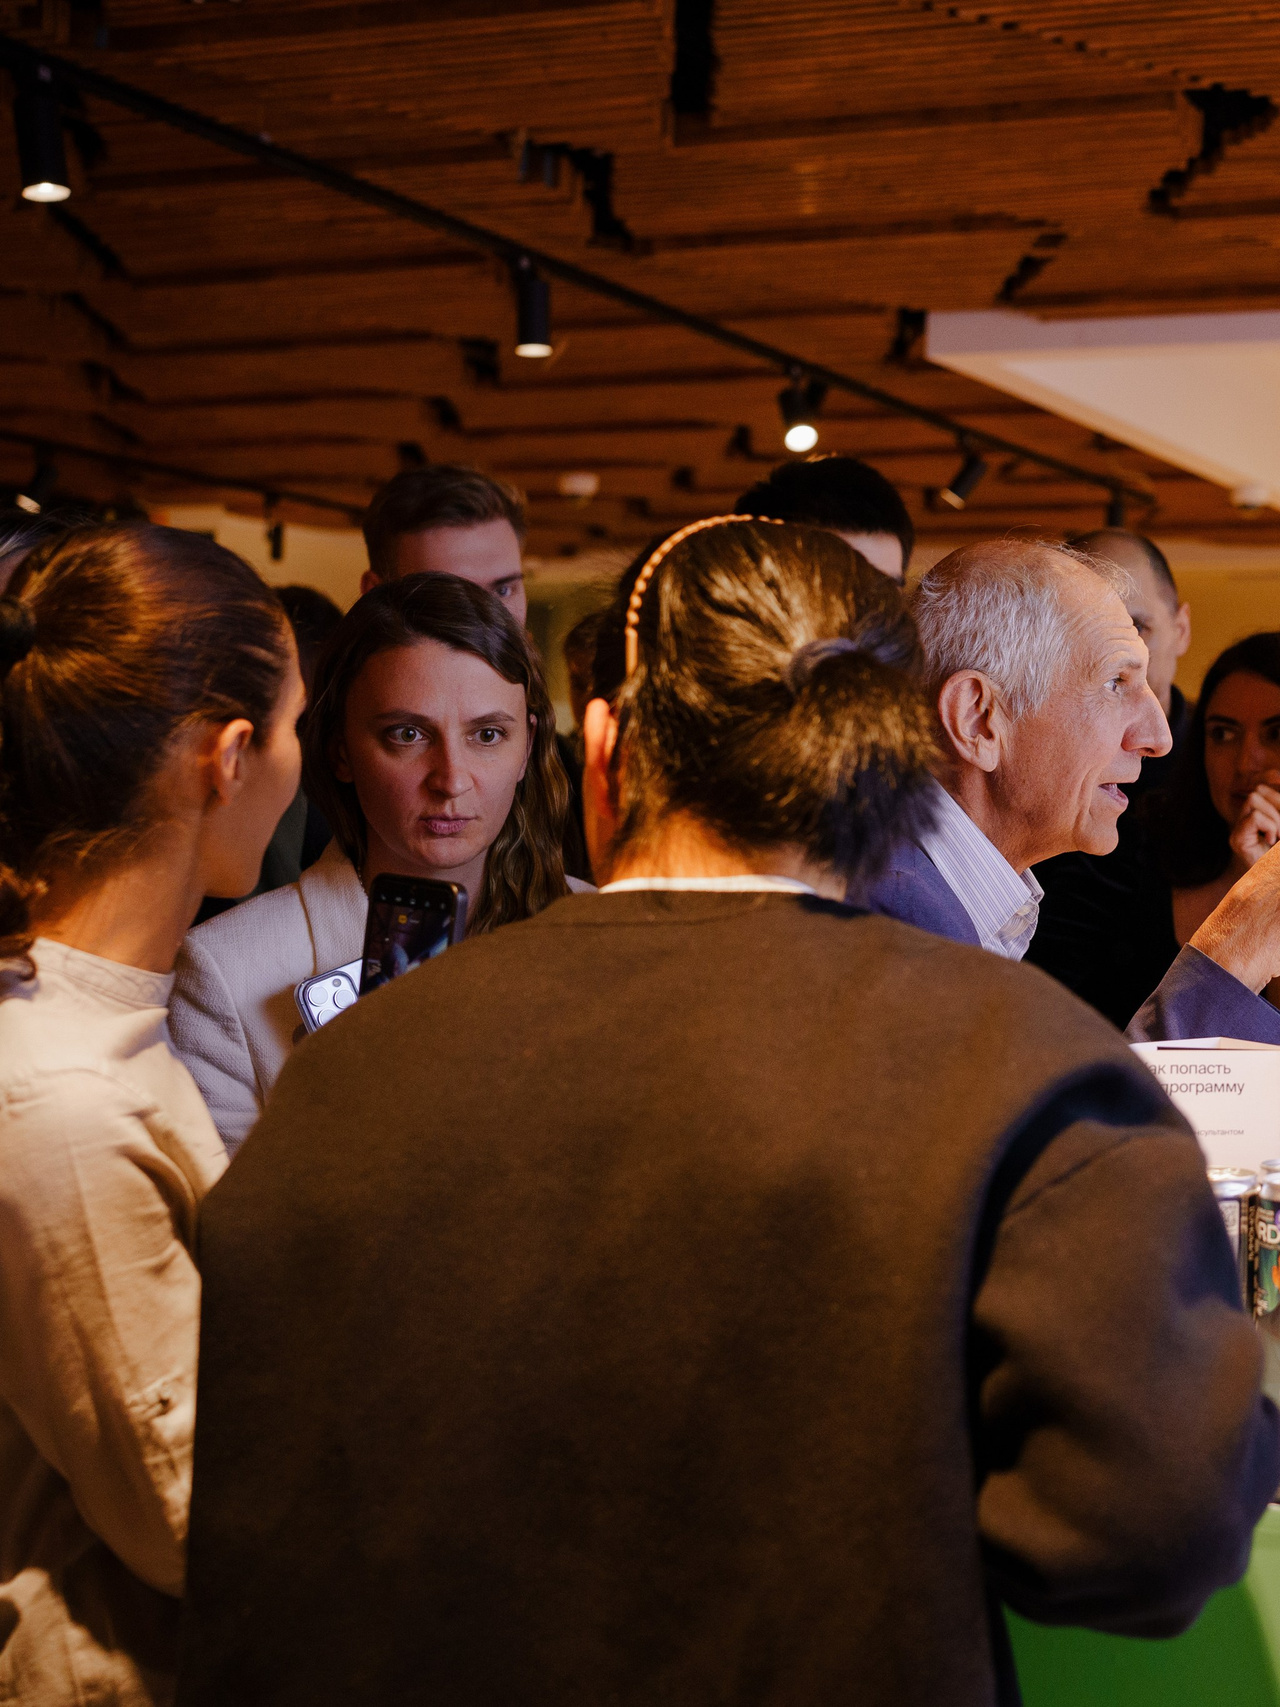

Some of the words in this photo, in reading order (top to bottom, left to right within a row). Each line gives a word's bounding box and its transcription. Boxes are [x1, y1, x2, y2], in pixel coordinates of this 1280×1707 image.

[1146, 1063, 1166, 1075] ак
[1170, 1063, 1232, 1075] попасть
[1195, 1129, 1245, 1137] нсультантом
